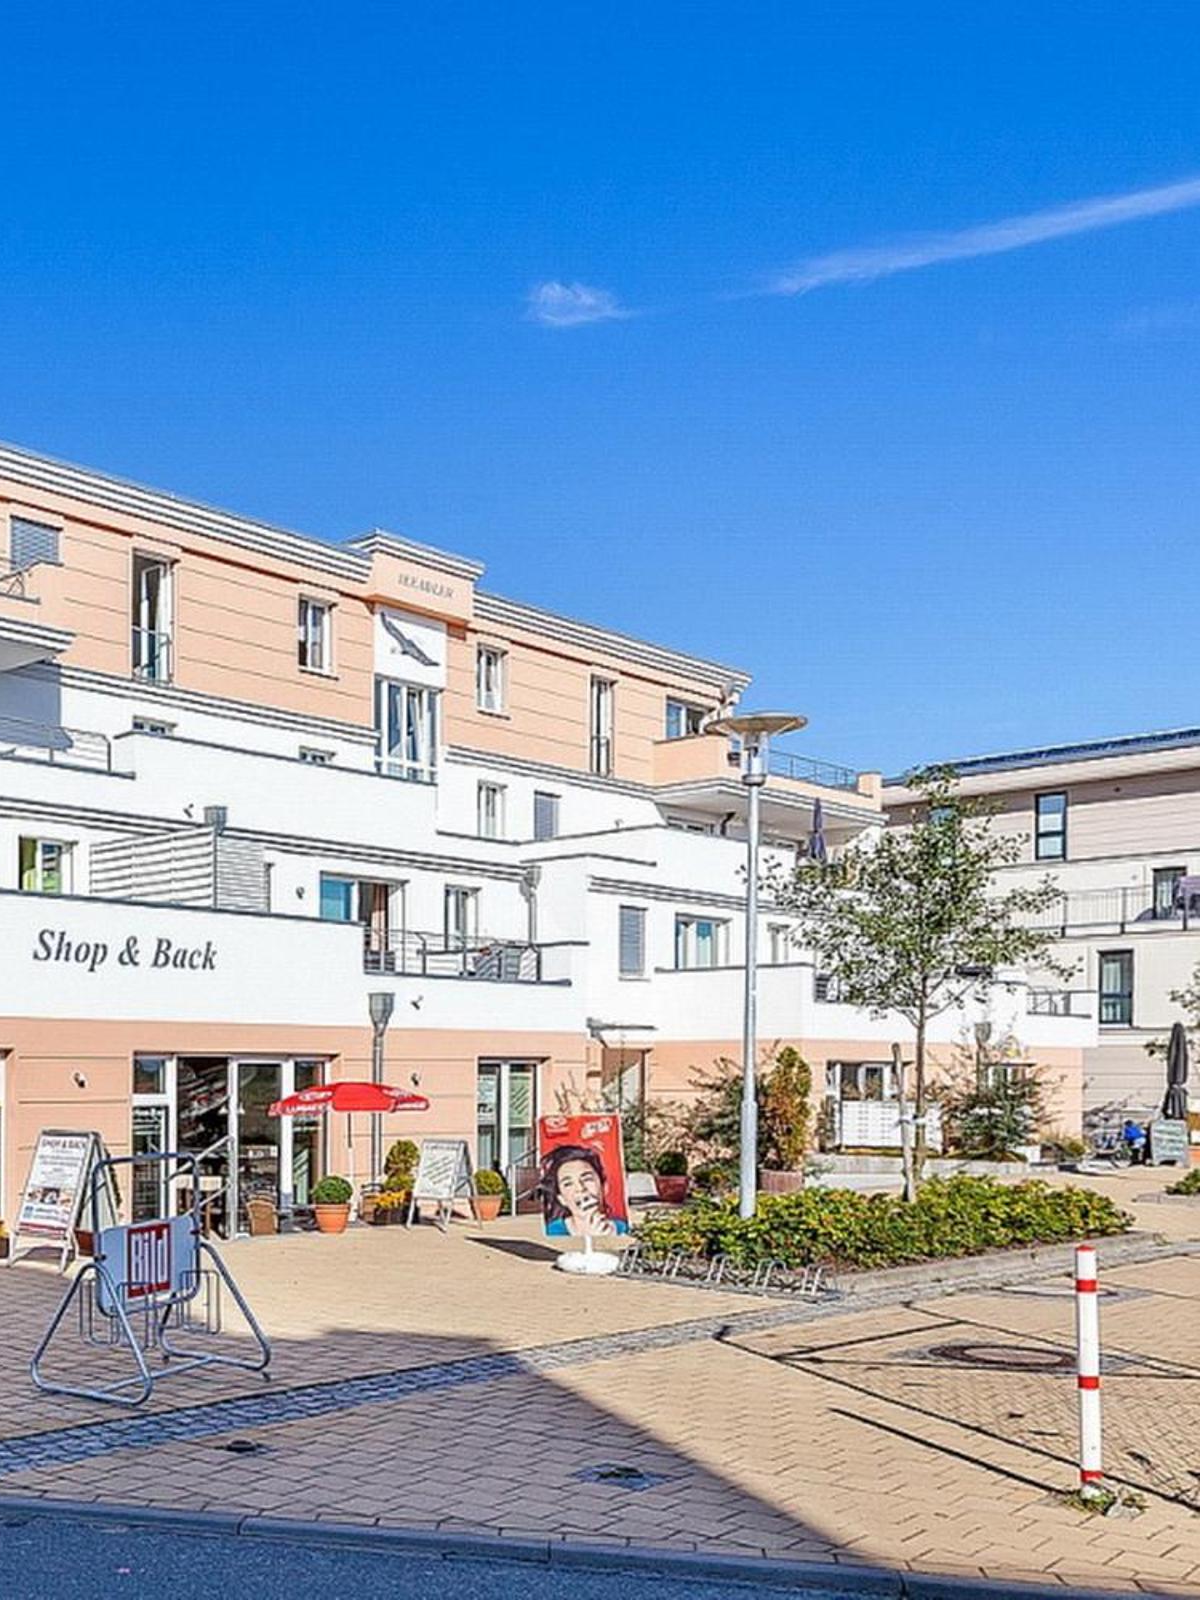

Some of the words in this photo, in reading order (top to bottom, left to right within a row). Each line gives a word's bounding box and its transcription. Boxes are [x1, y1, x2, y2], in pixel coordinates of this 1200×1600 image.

[32, 929, 107, 972] Shop
[117, 936, 139, 966] &
[151, 938, 216, 970] Back
